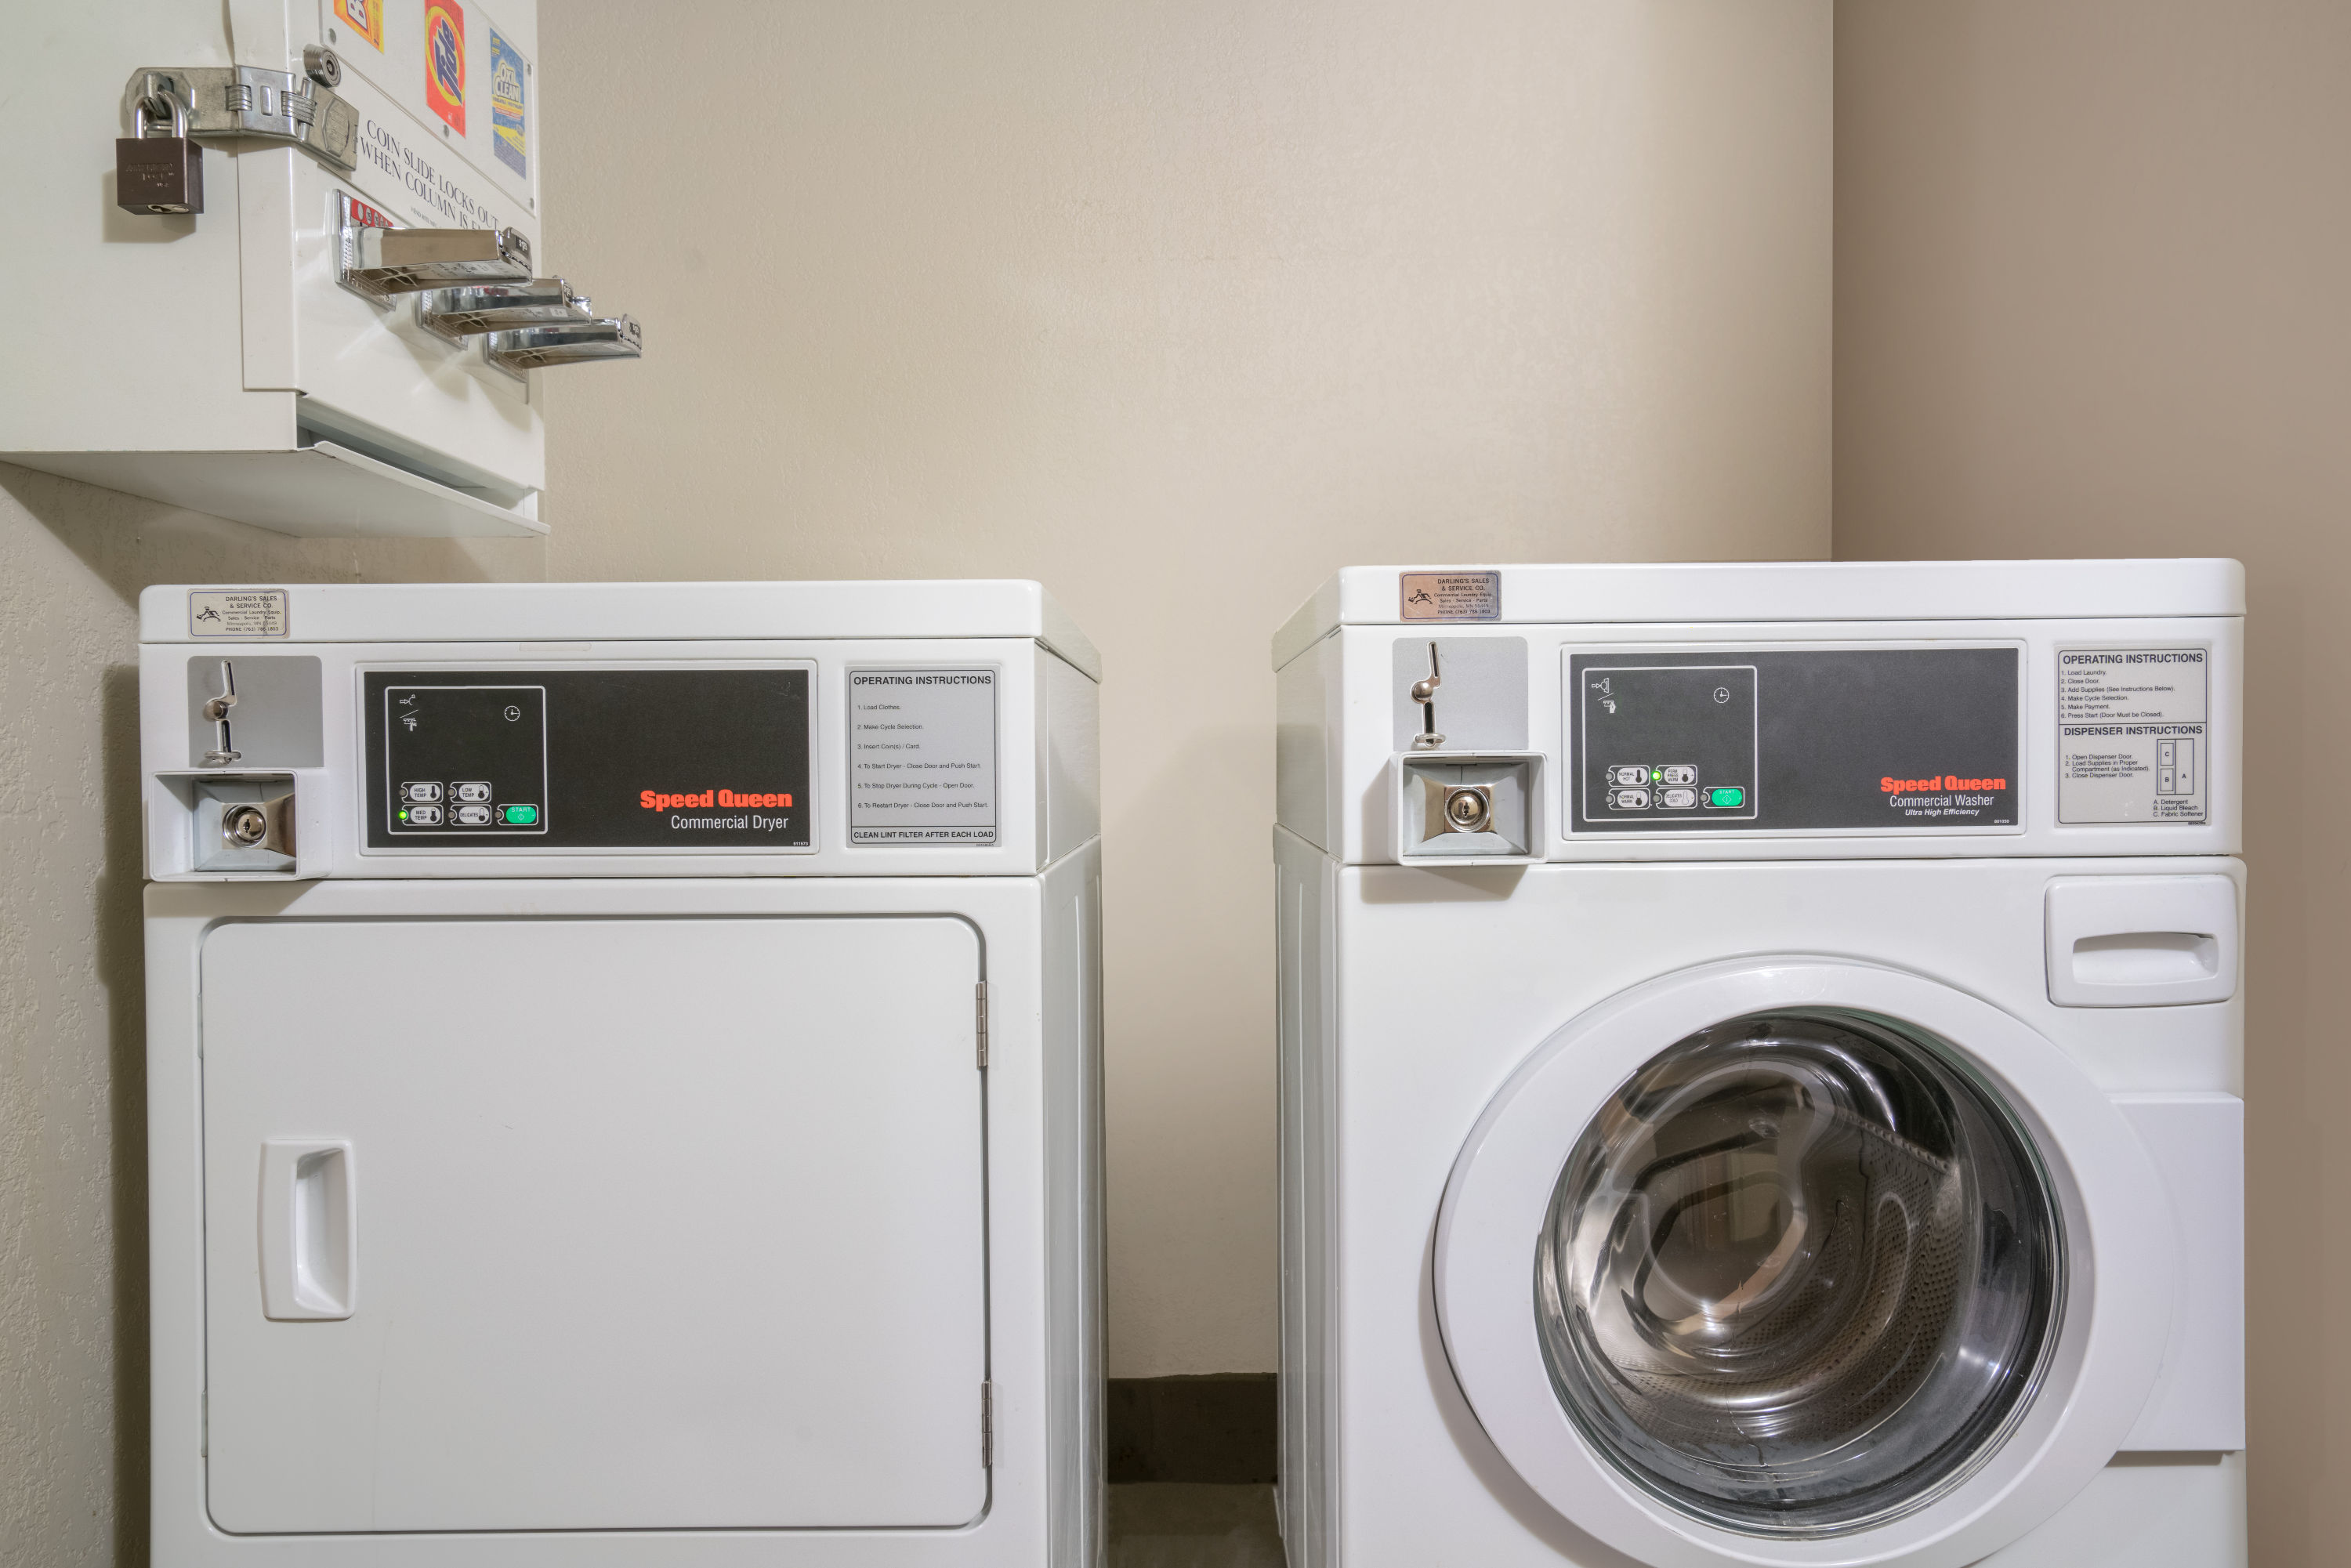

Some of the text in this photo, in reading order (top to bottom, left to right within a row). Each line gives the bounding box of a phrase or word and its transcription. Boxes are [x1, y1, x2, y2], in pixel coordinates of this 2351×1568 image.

[433, 18, 462, 107] Tide
[360, 136, 400, 181] WHEN
[406, 172, 455, 221] COLUMN
[460, 212, 468, 230] IS
[367, 120, 400, 157] COIN
[404, 148, 435, 185] SLIDE
[440, 175, 474, 214] LOCKS
[478, 206, 498, 229] OUT
[2063, 654, 2203, 664] OPERATING INSTRUCTIONS
[854, 676, 913, 685] OPERATING
[2126, 726, 2202, 734] INSTRUCTIONS
[1881, 776, 2005, 795] Speed Queen
[640, 789, 792, 812] Speed Queen
[1890, 795, 1994, 807] Commercial Washer
[672, 815, 788, 831] Commercial Dryer
